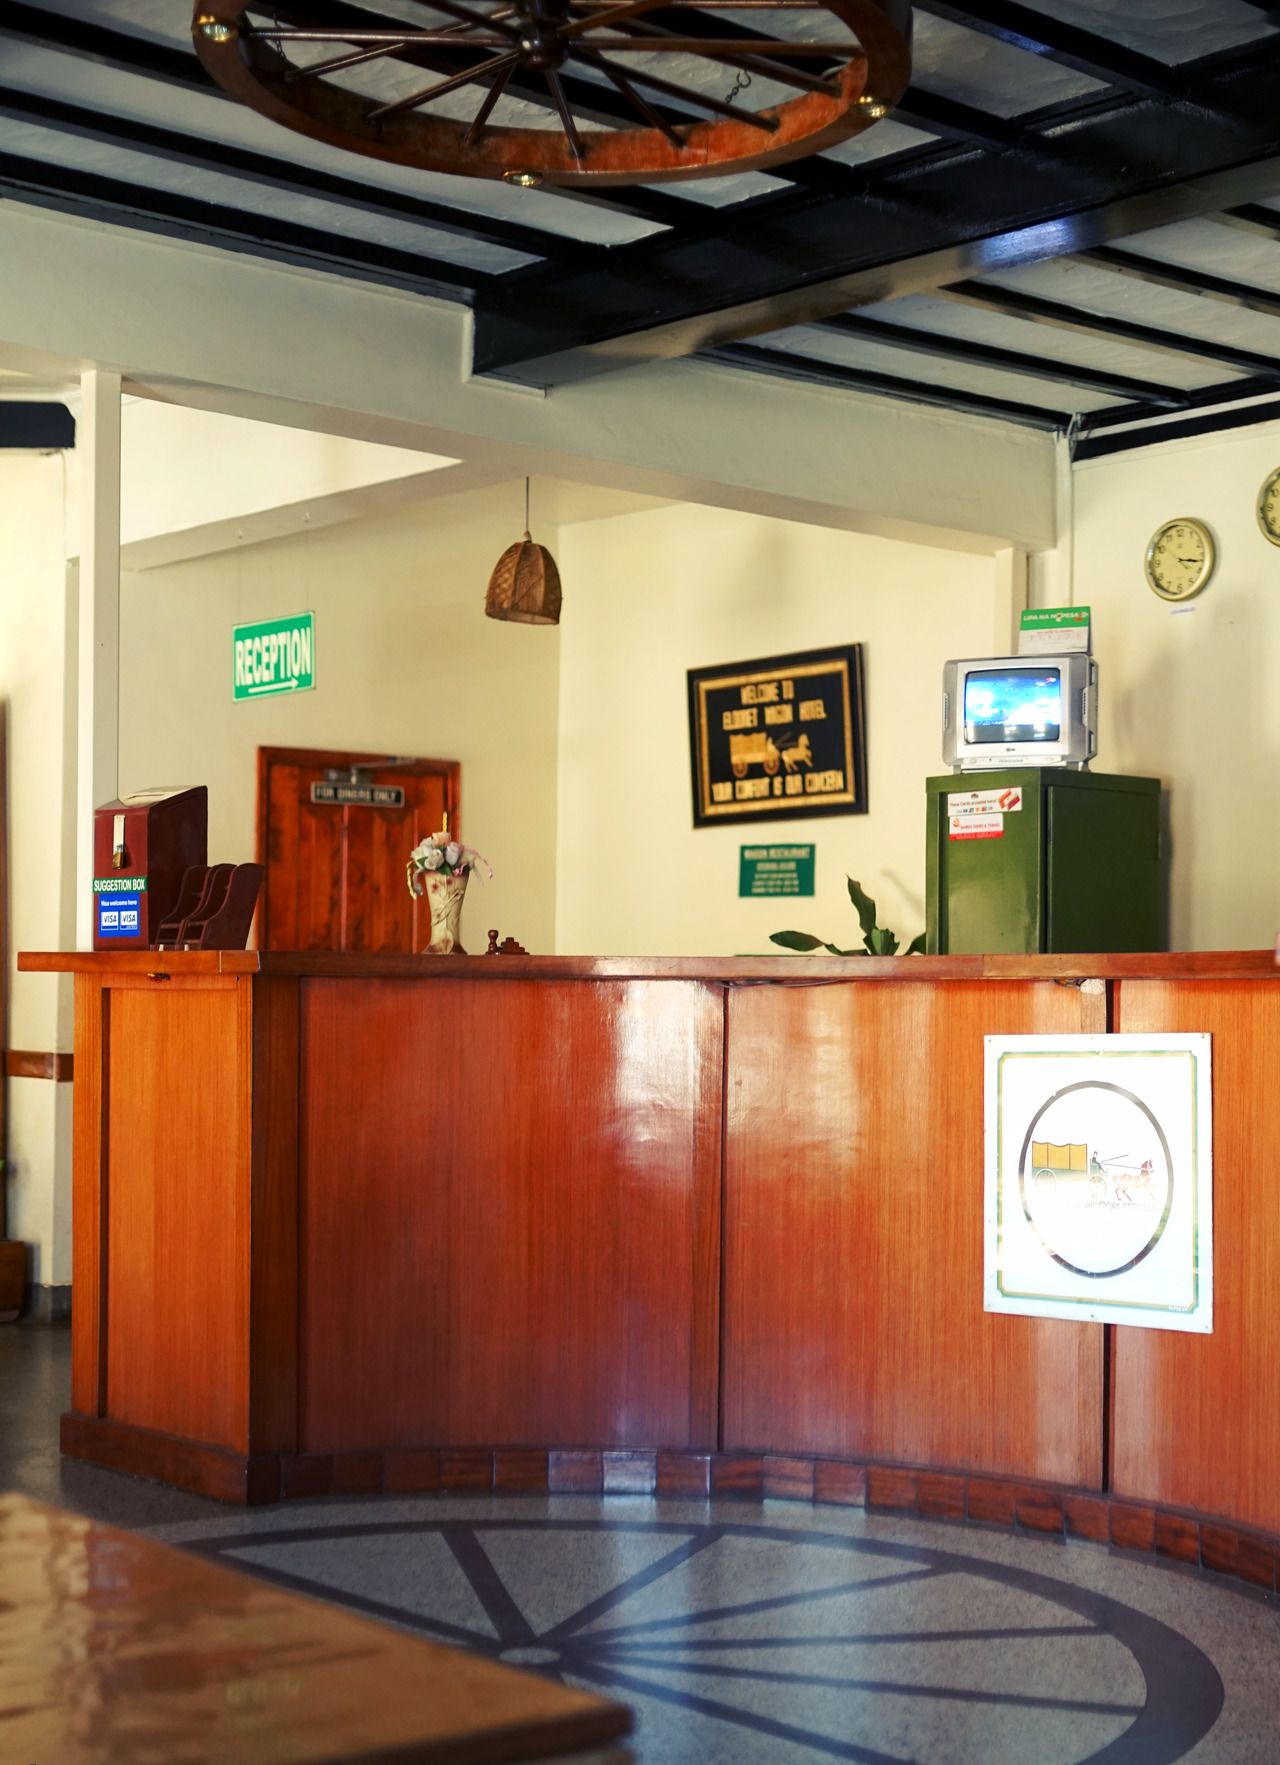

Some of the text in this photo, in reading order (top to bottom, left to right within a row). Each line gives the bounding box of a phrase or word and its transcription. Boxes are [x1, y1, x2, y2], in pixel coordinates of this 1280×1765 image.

[235, 626, 311, 687] RECEPTION
[741, 682, 779, 705] WELCOME
[723, 699, 827, 731] ELDORET WAGON HOTEL
[316, 787, 335, 798] FOR
[374, 790, 397, 801] ONLY
[712, 781, 733, 802] YOUR
[735, 776, 770, 800] COMFORT
[785, 774, 803, 795] OUR
[805, 769, 844, 793] CONCERN
[94, 879, 145, 891] SUGGESTION BOX
[104, 914, 135, 923] VISA VISA
